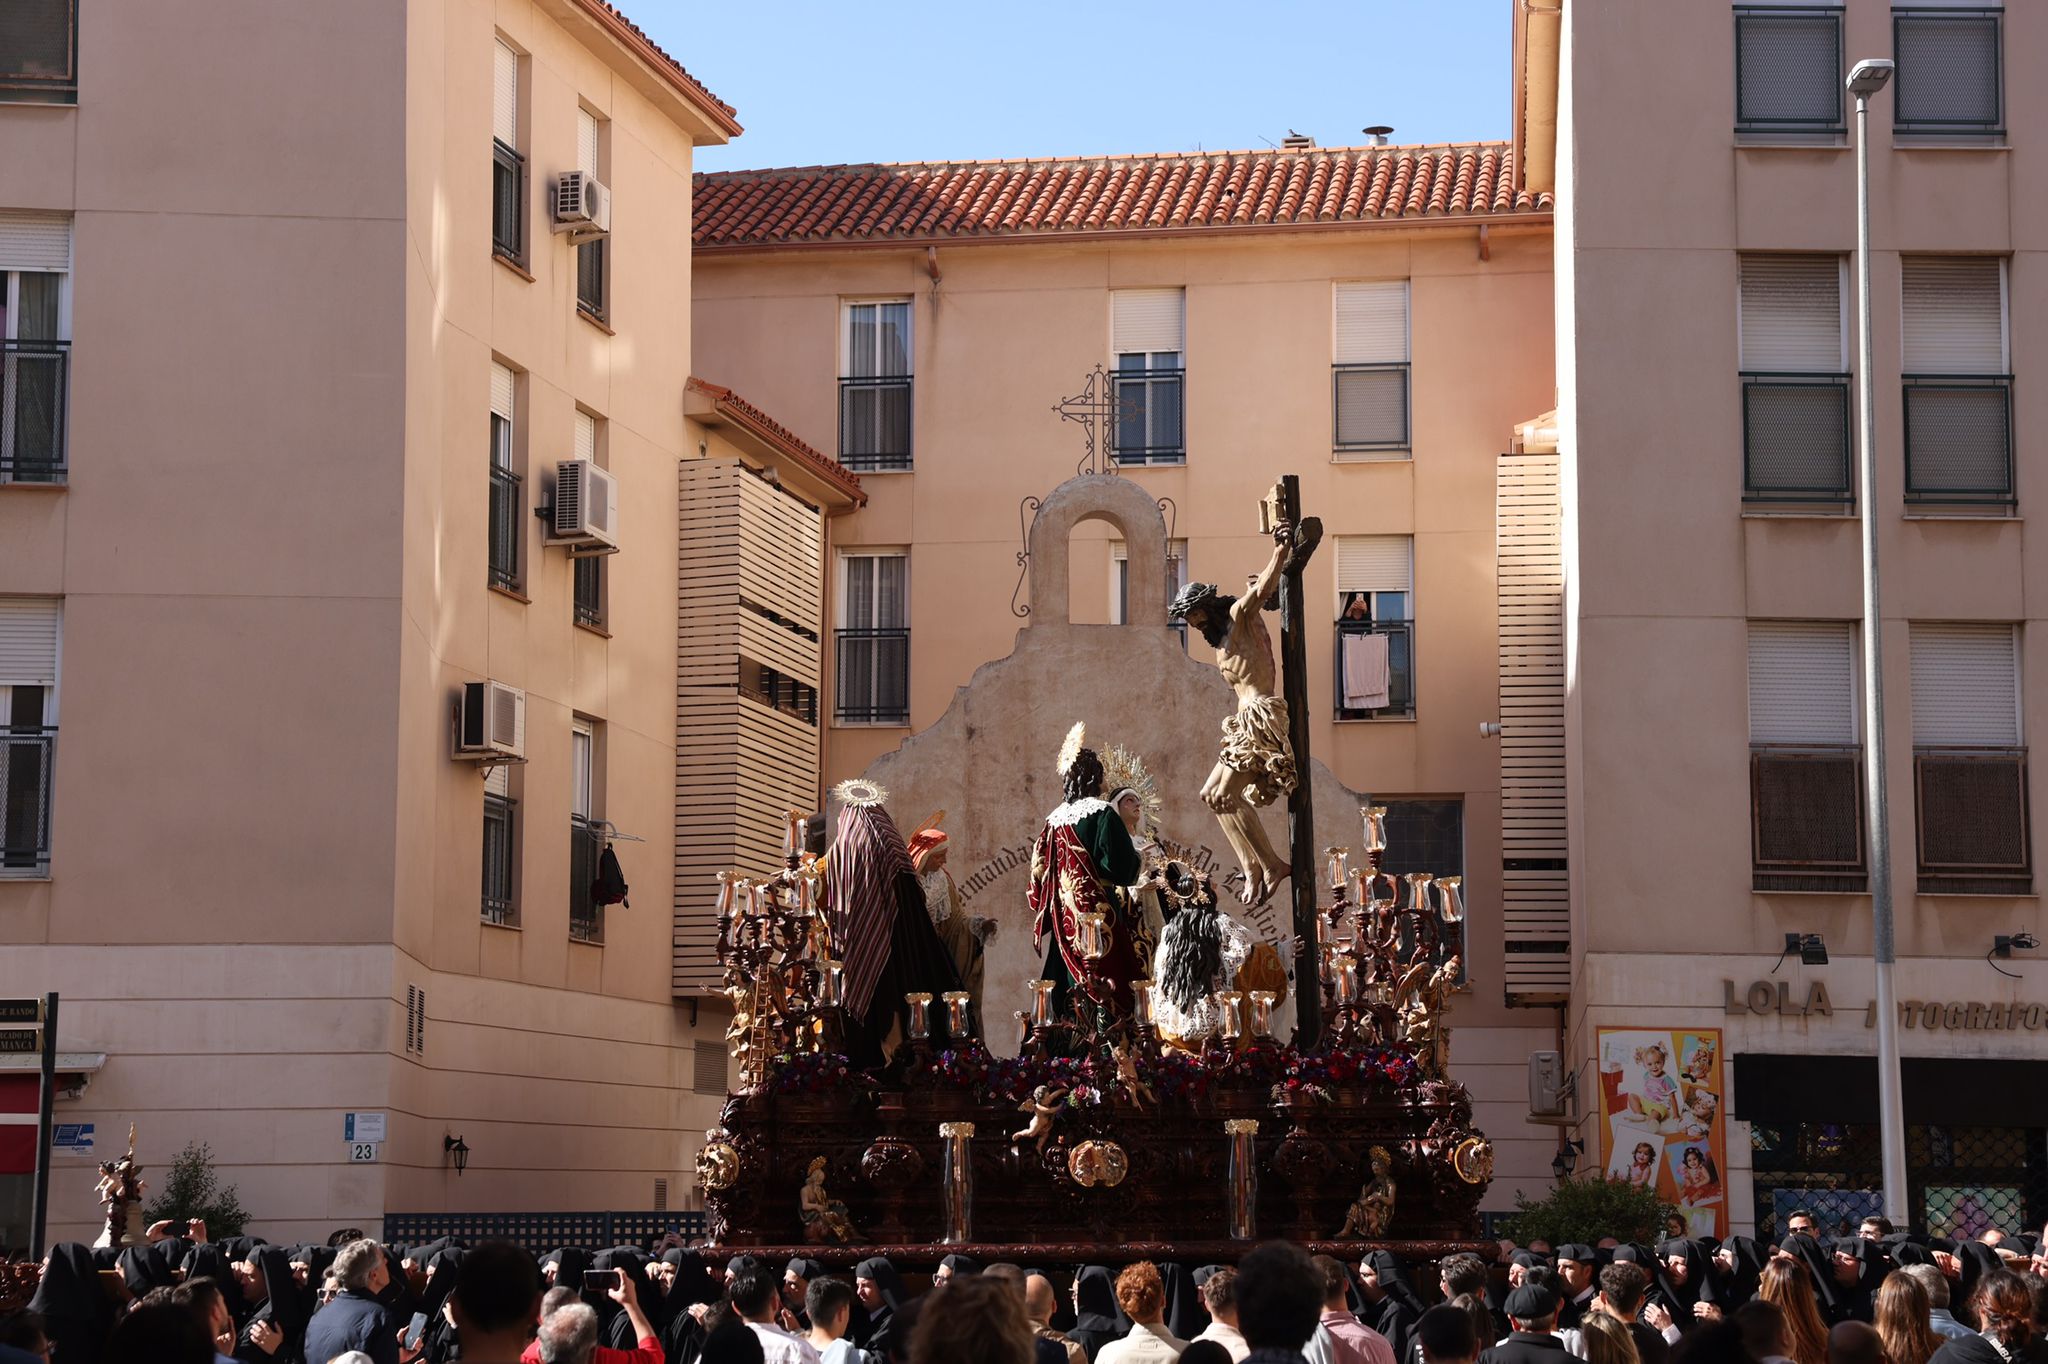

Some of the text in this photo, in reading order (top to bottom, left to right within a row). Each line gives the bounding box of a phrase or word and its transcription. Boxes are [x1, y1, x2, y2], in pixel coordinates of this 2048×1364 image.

[1723, 979, 1833, 1017] LOLA
[10, 1008, 35, 1016] RANDO
[355, 1144, 373, 1160] 23
